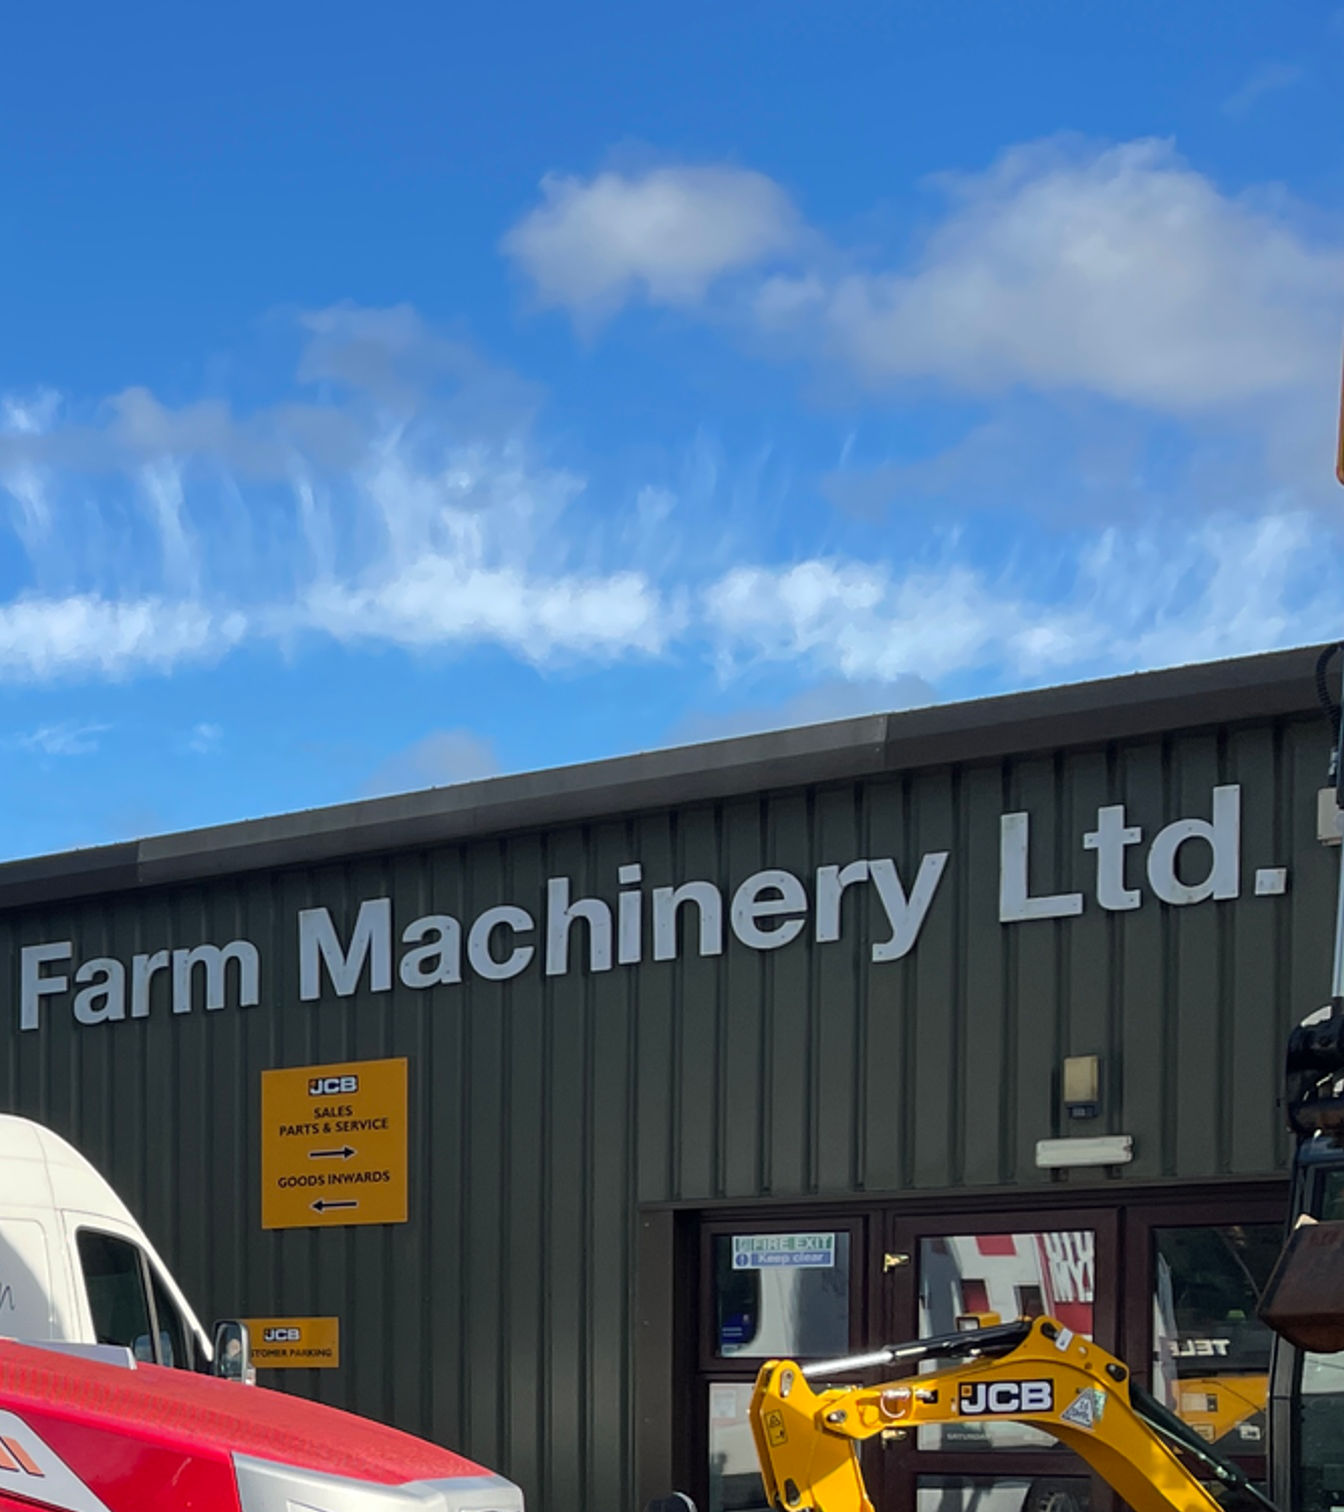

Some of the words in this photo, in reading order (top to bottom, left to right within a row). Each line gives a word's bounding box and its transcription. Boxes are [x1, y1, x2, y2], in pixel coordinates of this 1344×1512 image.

[20, 941, 260, 1031] Farm
[299, 851, 950, 1001] Machinery
[999, 784, 1288, 922] Ltd.
[310, 1077, 358, 1095] JCB
[314, 1105, 353, 1119] SALES
[279, 1123, 319, 1137] PARTS
[322, 1122, 332, 1134] &
[335, 1117, 389, 1133] SERVICE
[277, 1174, 325, 1189] GOODS
[328, 1170, 390, 1186] INWARDS
[753, 1237, 790, 1251] FIRE
[795, 1236, 832, 1250] EXIT
[758, 1252, 790, 1265] Keep
[793, 1252, 824, 1264] clear
[265, 1328, 300, 1342] JCB
[961, 1381, 1053, 1413] JCB
